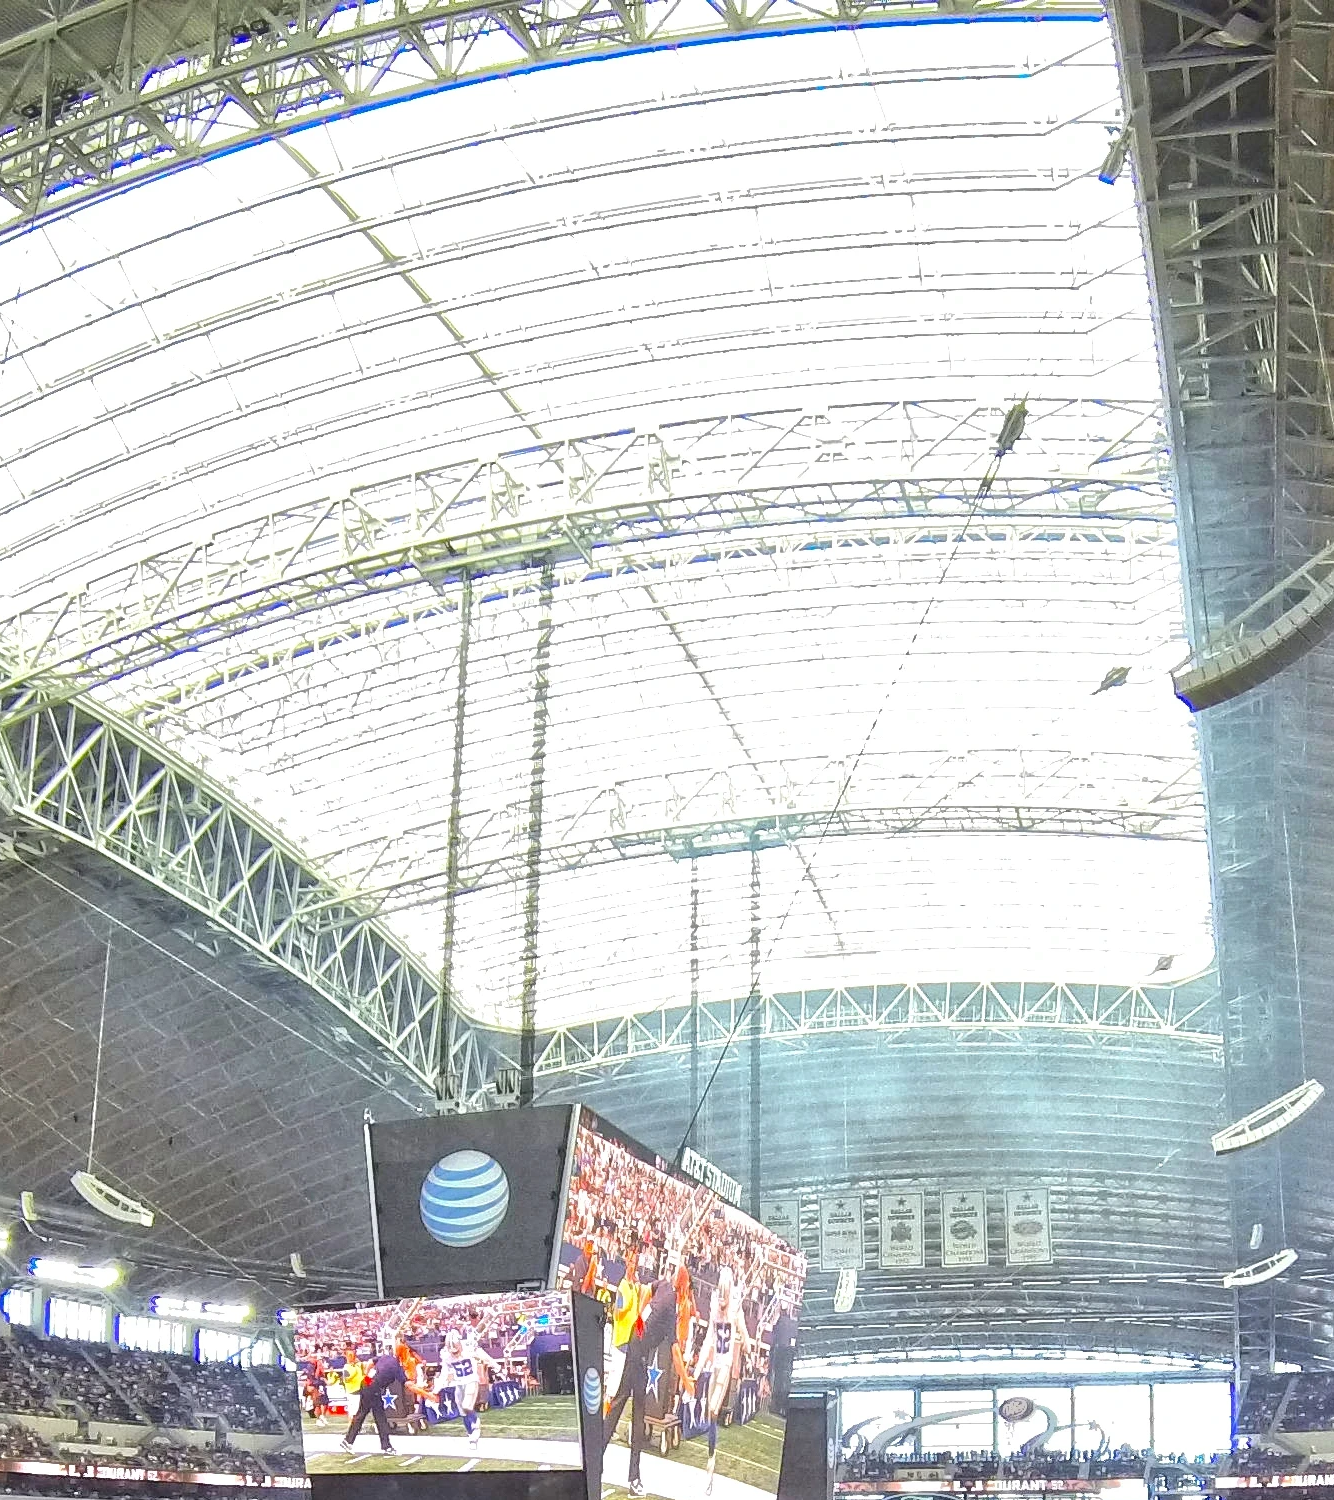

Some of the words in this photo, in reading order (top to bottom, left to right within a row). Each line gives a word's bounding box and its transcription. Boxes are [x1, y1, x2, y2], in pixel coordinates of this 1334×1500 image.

[681, 1146, 707, 1183] AT&T
[705, 1161, 742, 1208] STADIUM
[715, 1322, 731, 1353] 52
[451, 1361, 473, 1378] 52
[995, 1480, 1047, 1491] DURANT
